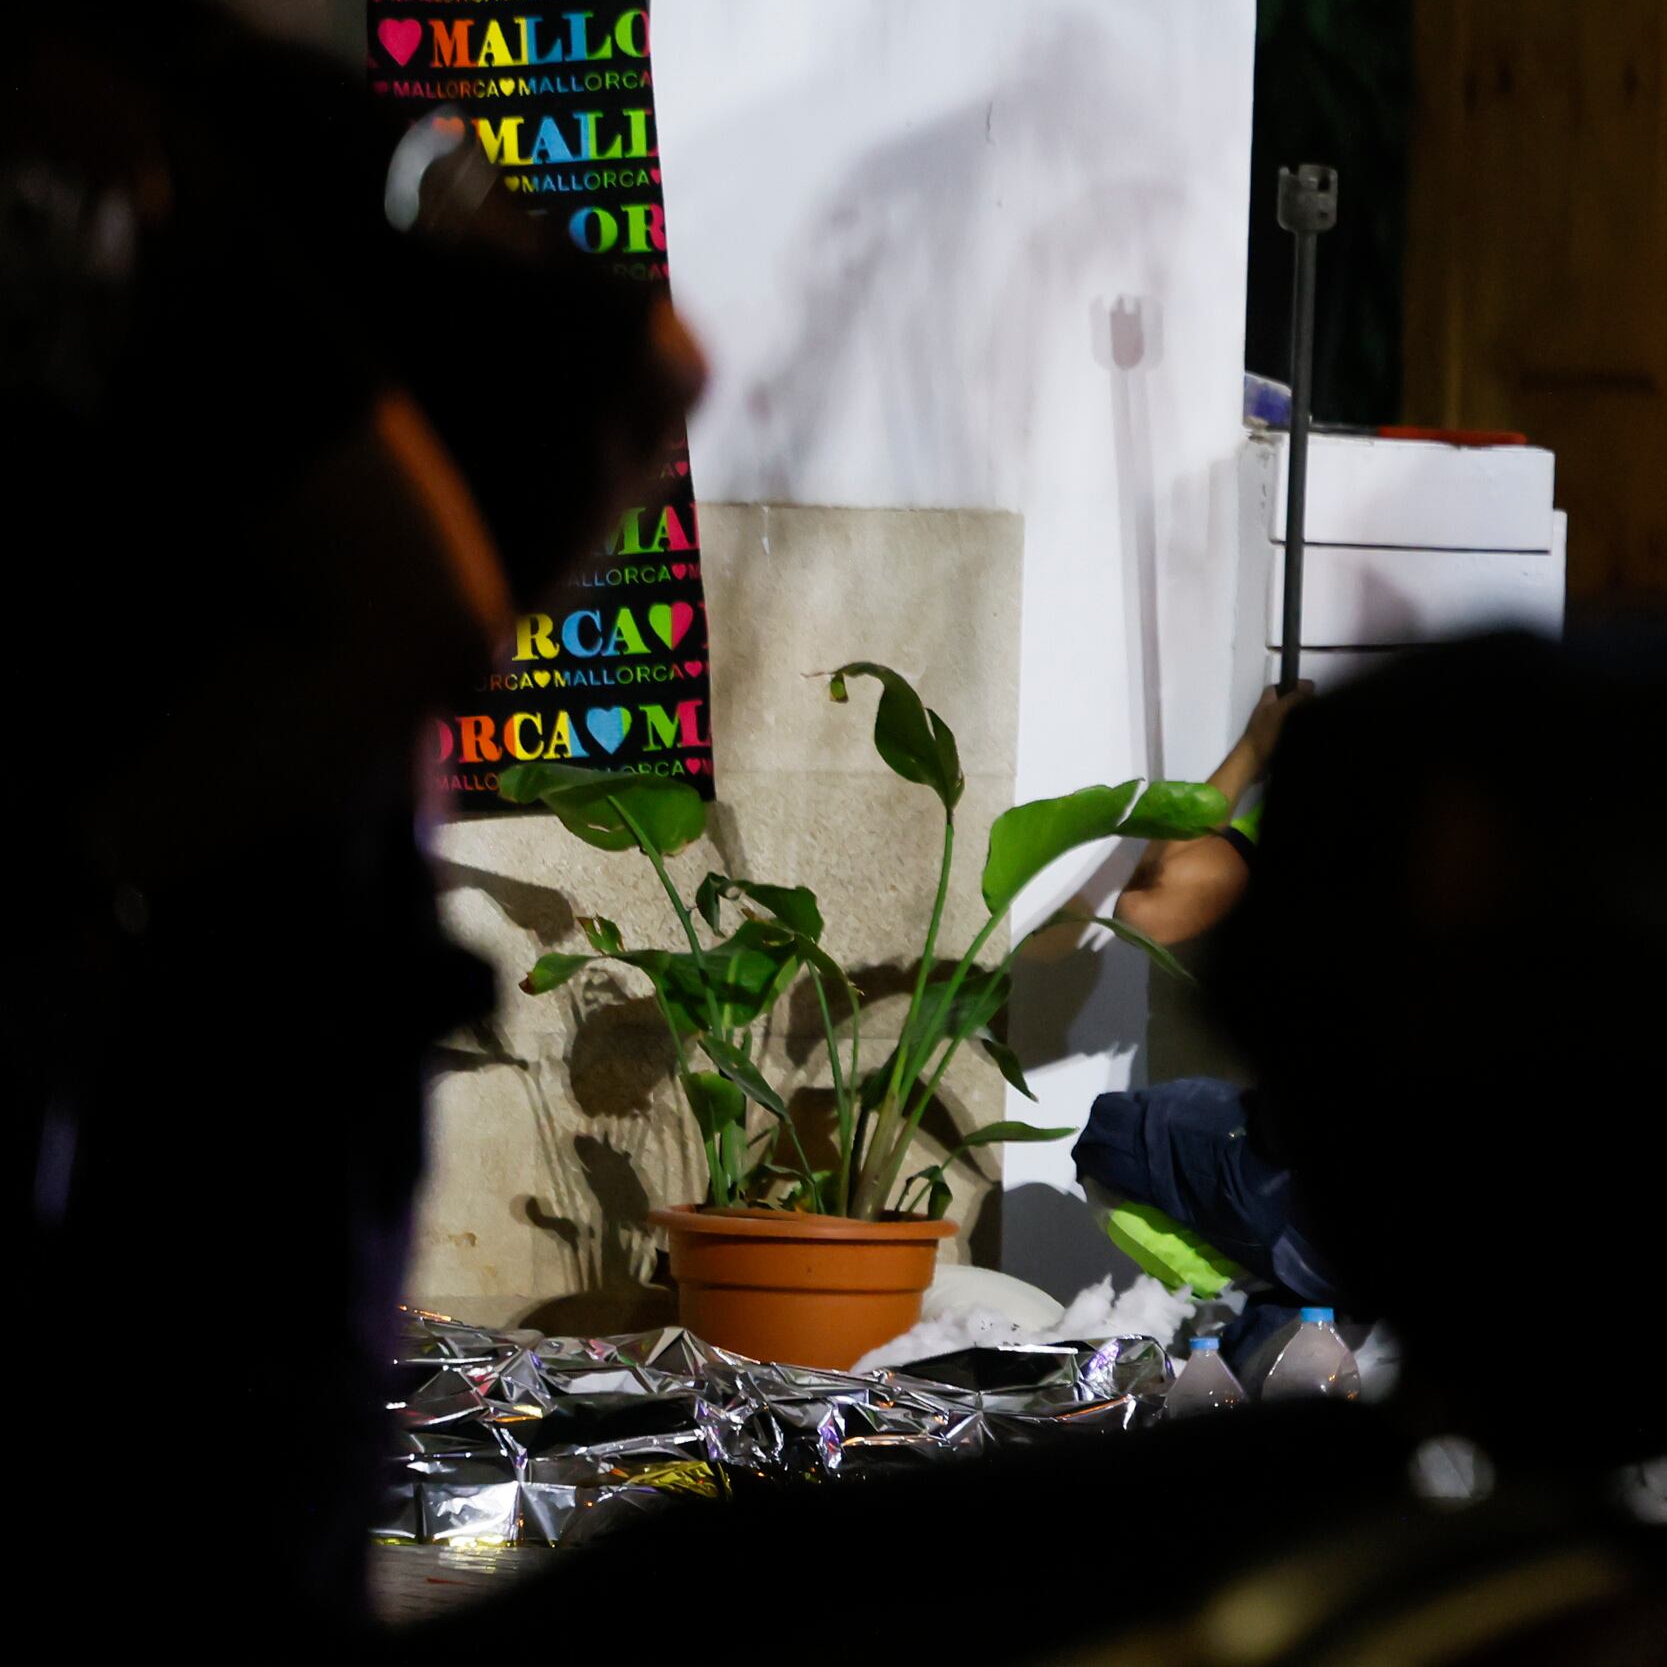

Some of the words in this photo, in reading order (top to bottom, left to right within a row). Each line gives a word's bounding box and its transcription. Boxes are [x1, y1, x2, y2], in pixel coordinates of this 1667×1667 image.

[427, 8, 651, 69] MALLO
[392, 79, 500, 100] MALLORCA
[520, 169, 650, 193] MALLORCA
[554, 662, 686, 688] MALLORCA
